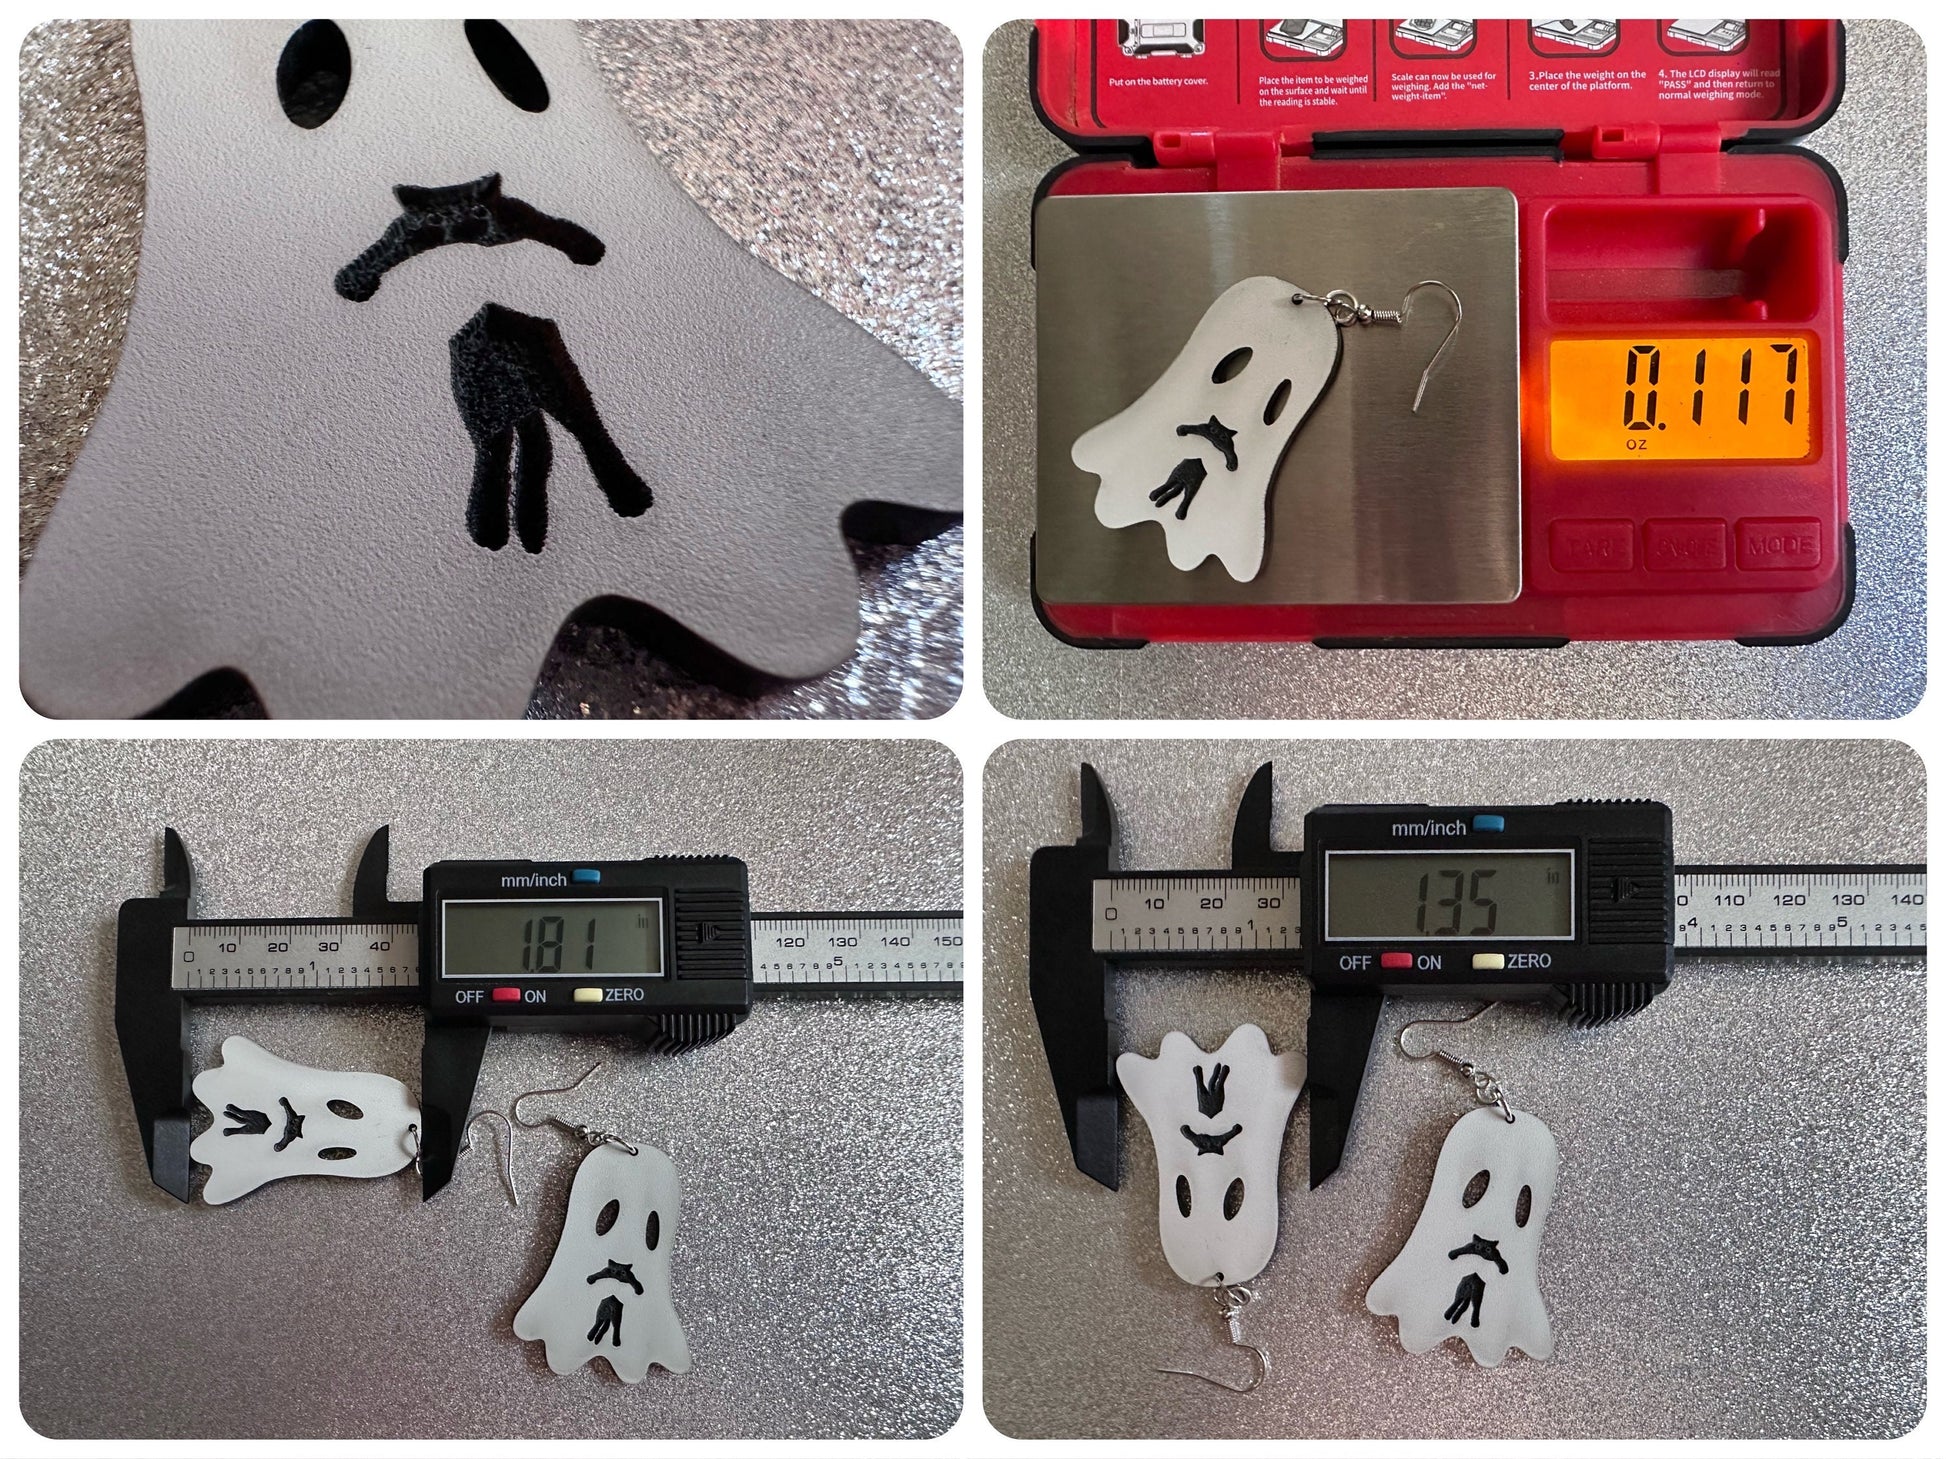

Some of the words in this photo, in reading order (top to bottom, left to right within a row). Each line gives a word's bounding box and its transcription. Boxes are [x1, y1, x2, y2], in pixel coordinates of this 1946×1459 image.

[1259, 75, 1280, 84] Place
[1281, 75, 1294, 84] the
[1295, 75, 1313, 84] item
[1314, 75, 1323, 84] to
[1324, 75, 1334, 84] be
[1336, 74, 1368, 85] weighed
[1391, 73, 1413, 81] Scale
[1415, 73, 1430, 81] can
[1451, 72, 1461, 80] be
[1463, 71, 1483, 80] used
[1484, 71, 1496, 80] for
[1565, 71, 1581, 80] the
[1583, 70, 1615, 81] weight
[1616, 71, 1629, 79] on
[1631, 69, 1647, 79] the
[1658, 69, 1668, 78] 4.
[1670, 69, 1687, 78] The
[1689, 69, 1706, 78] LCD
[1708, 69, 1741, 80] display
[1742, 69, 1758, 78] will
[1760, 68, 1780, 78] read
[1109, 77, 1123, 86] Put
[1125, 78, 1136, 86] on
[1137, 77, 1151, 86] the
[1152, 77, 1182, 87] battery
[1184, 77, 1208, 85] cover.
[1391, 82, 1431, 92] weighing.
[1433, 82, 1450, 90] Add
[1451, 81, 1465, 90] the
[1529, 82, 1558, 91] center
[1561, 81, 1571, 90] of
[1572, 81, 1587, 90] the
[1590, 81, 1633, 92] platform.
[1658, 80, 1691, 89] "PASS"
[1693, 79, 1711, 88] and
[1713, 79, 1733, 88] then
[1735, 80, 1763, 88] return
[1765, 80, 1775, 88] to
[1271, 87, 1284, 95] the
[1285, 86, 1312, 95] surface
[1314, 85, 1329, 94] and
[1331, 85, 1347, 94] wait
[1349, 85, 1368, 94] until
[1658, 90, 1691, 99] normal
[1693, 90, 1734, 101] weighing
[1259, 98, 1272, 106] the
[1273, 97, 1303, 107] reading
[1304, 96, 1311, 105] is
[1312, 96, 1338, 106] stable.
[1623, 344, 1797, 430] 0.117
[1748, 536, 1815, 555] MODE
[1392, 819, 1467, 837] mm/inch
[501, 872, 567, 888] mm/inch
[1145, 898, 1164, 910] 10
[1200, 898, 1223, 909] 20
[1258, 898, 1280, 909] 30
[1714, 894, 1744, 906] 110
[1774, 894, 1806, 906] 120
[1832, 894, 1865, 906] 130
[1891, 894, 1924, 906] 140
[1687, 917, 1698, 928] 4
[1837, 916, 1848, 927] 5
[218, 943, 236, 952] 10
[268, 943, 288, 952] 20
[318, 942, 339, 952] 30
[370, 941, 390, 951] 40
[776, 937, 805, 948] 120
[828, 937, 858, 948] 130
[880, 936, 910, 947] 140
[933, 936, 963, 946] 150
[310, 961, 315, 970] 1
[834, 956, 843, 966] 5
[1339, 955, 1372, 970] OFF
[1417, 955, 1442, 970] ON
[1508, 954, 1551, 969] ZERO
[455, 990, 485, 1003] OFF
[524, 989, 546, 1003] ON
[605, 988, 644, 1001] ZERO
